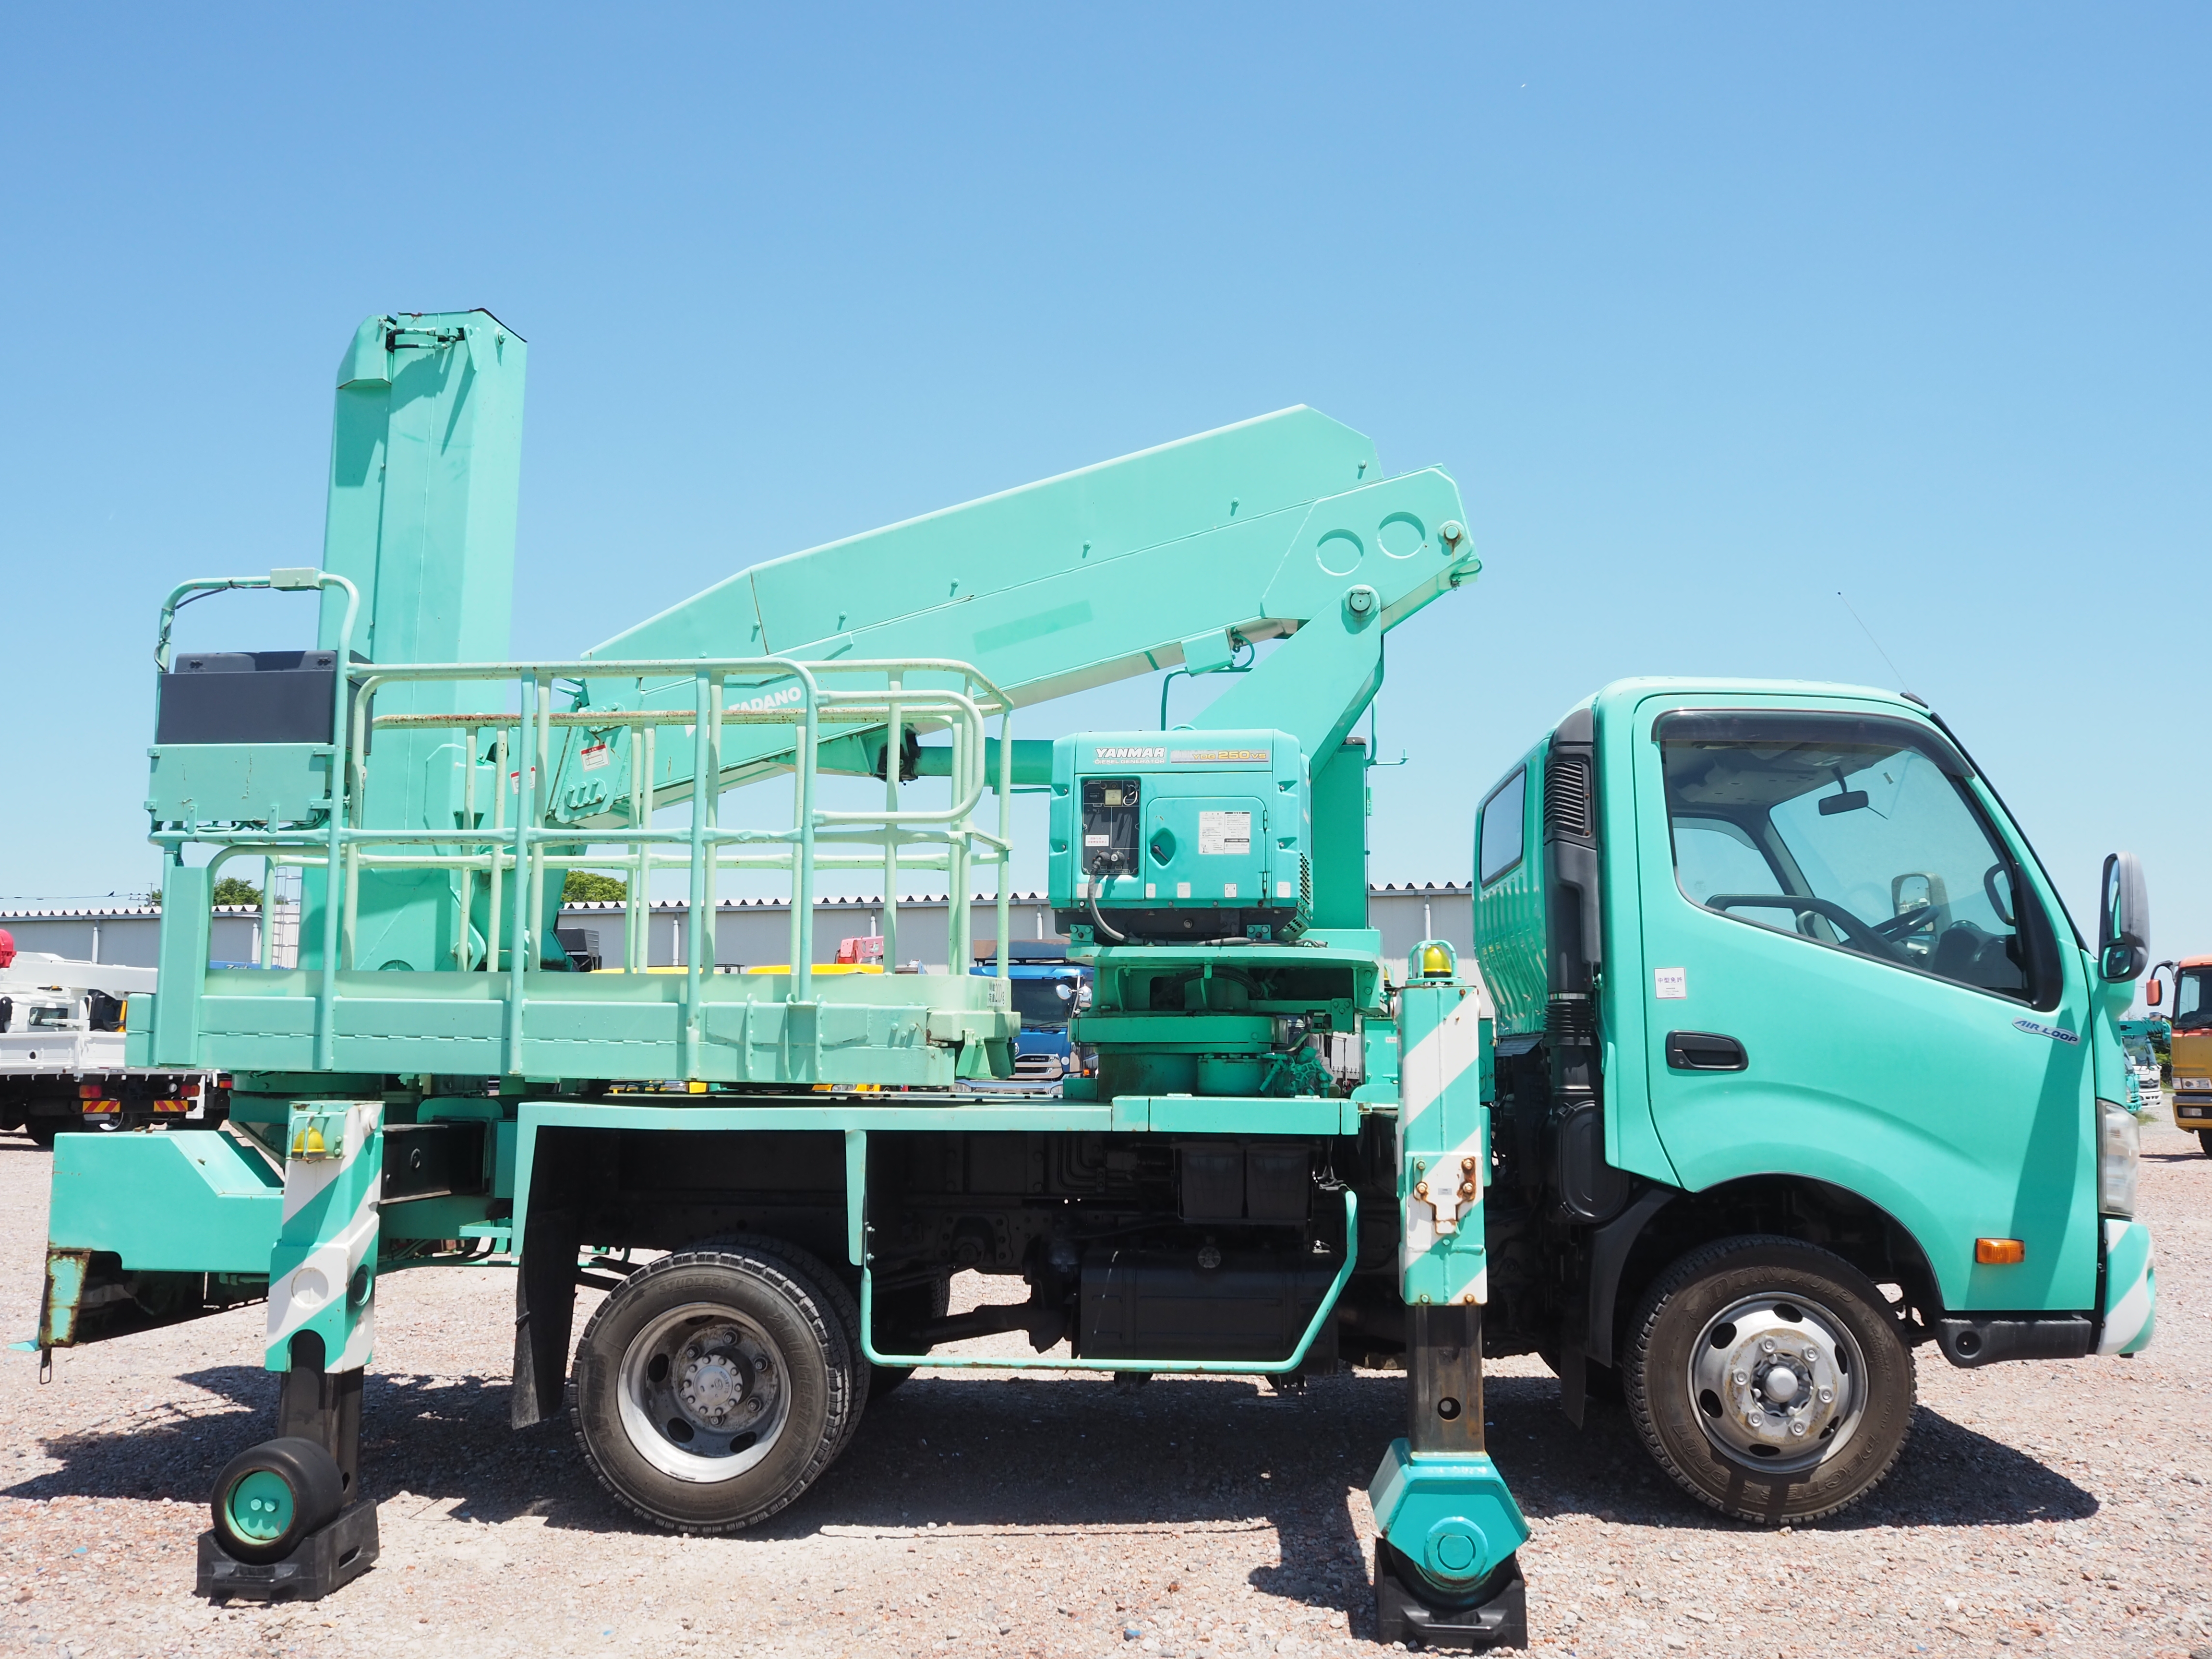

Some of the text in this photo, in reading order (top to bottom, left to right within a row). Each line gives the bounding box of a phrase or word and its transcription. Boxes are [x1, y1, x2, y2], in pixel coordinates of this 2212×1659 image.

[1095, 747, 1165, 758] YANMAR
[1218, 750, 1250, 759] 250
[2014, 1020, 2078, 1043] AIR LOOP
[659, 1277, 731, 1294] STUDLESS
[1705, 1265, 1856, 1308] DUNLOP
[768, 1312, 814, 1463] BRIDGESTONE
[1672, 1424, 1879, 1500] DECTE P001
